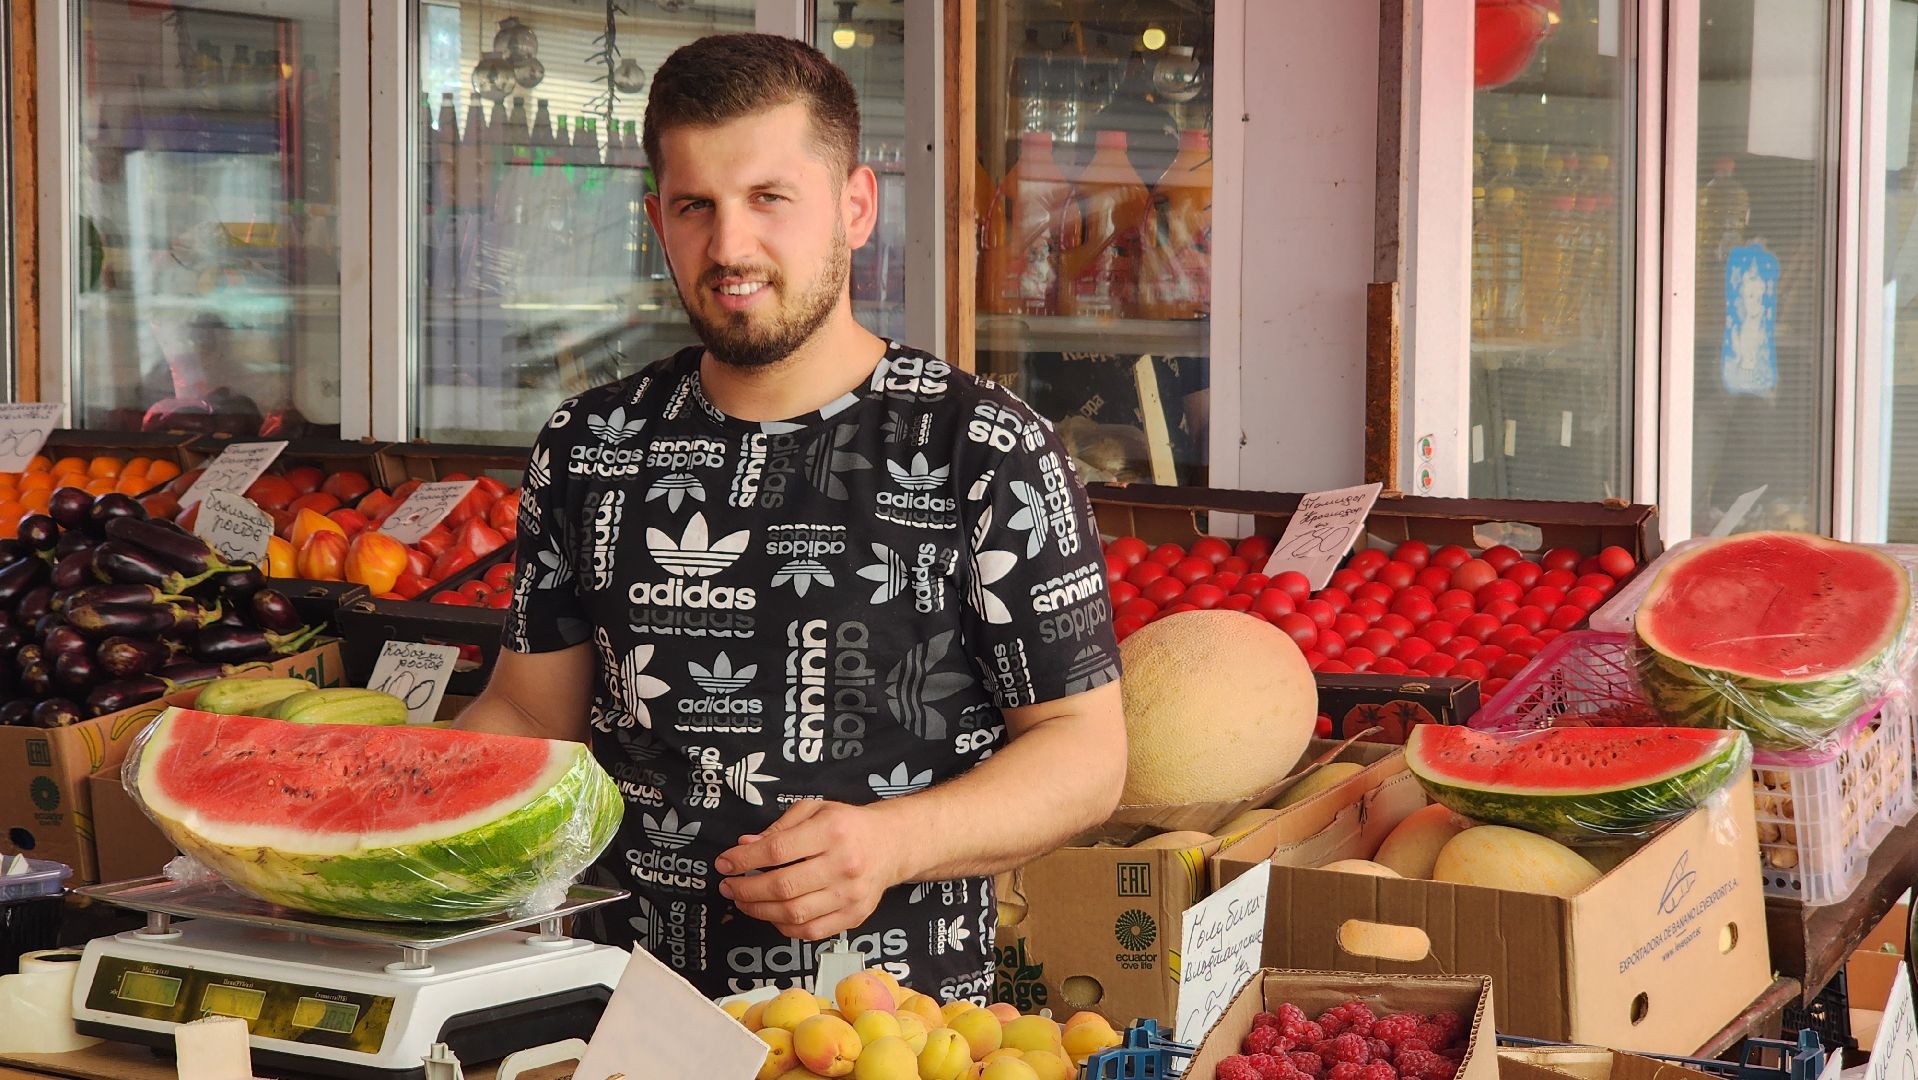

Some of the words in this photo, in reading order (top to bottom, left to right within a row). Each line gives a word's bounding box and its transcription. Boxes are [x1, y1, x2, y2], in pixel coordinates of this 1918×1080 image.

[570, 442, 644, 464] adidas
[646, 451, 725, 471] adidas
[876, 491, 956, 512] adidas
[1039, 455, 1070, 558] adidas
[765, 540, 846, 558] adidas
[911, 542, 937, 614] adidas
[628, 577, 757, 611] adidas
[677, 695, 763, 714] adidas
[832, 620, 878, 761] adidas
[625, 848, 709, 876] adidas
[1119, 865, 1149, 895] EAC
[666, 900, 688, 969] adidas
[1619, 933, 1663, 974] EXPORTADORA
[1671, 907, 1697, 936] BANANO
[1115, 951, 1158, 963] ecuador
[1140, 961, 1153, 970] life
